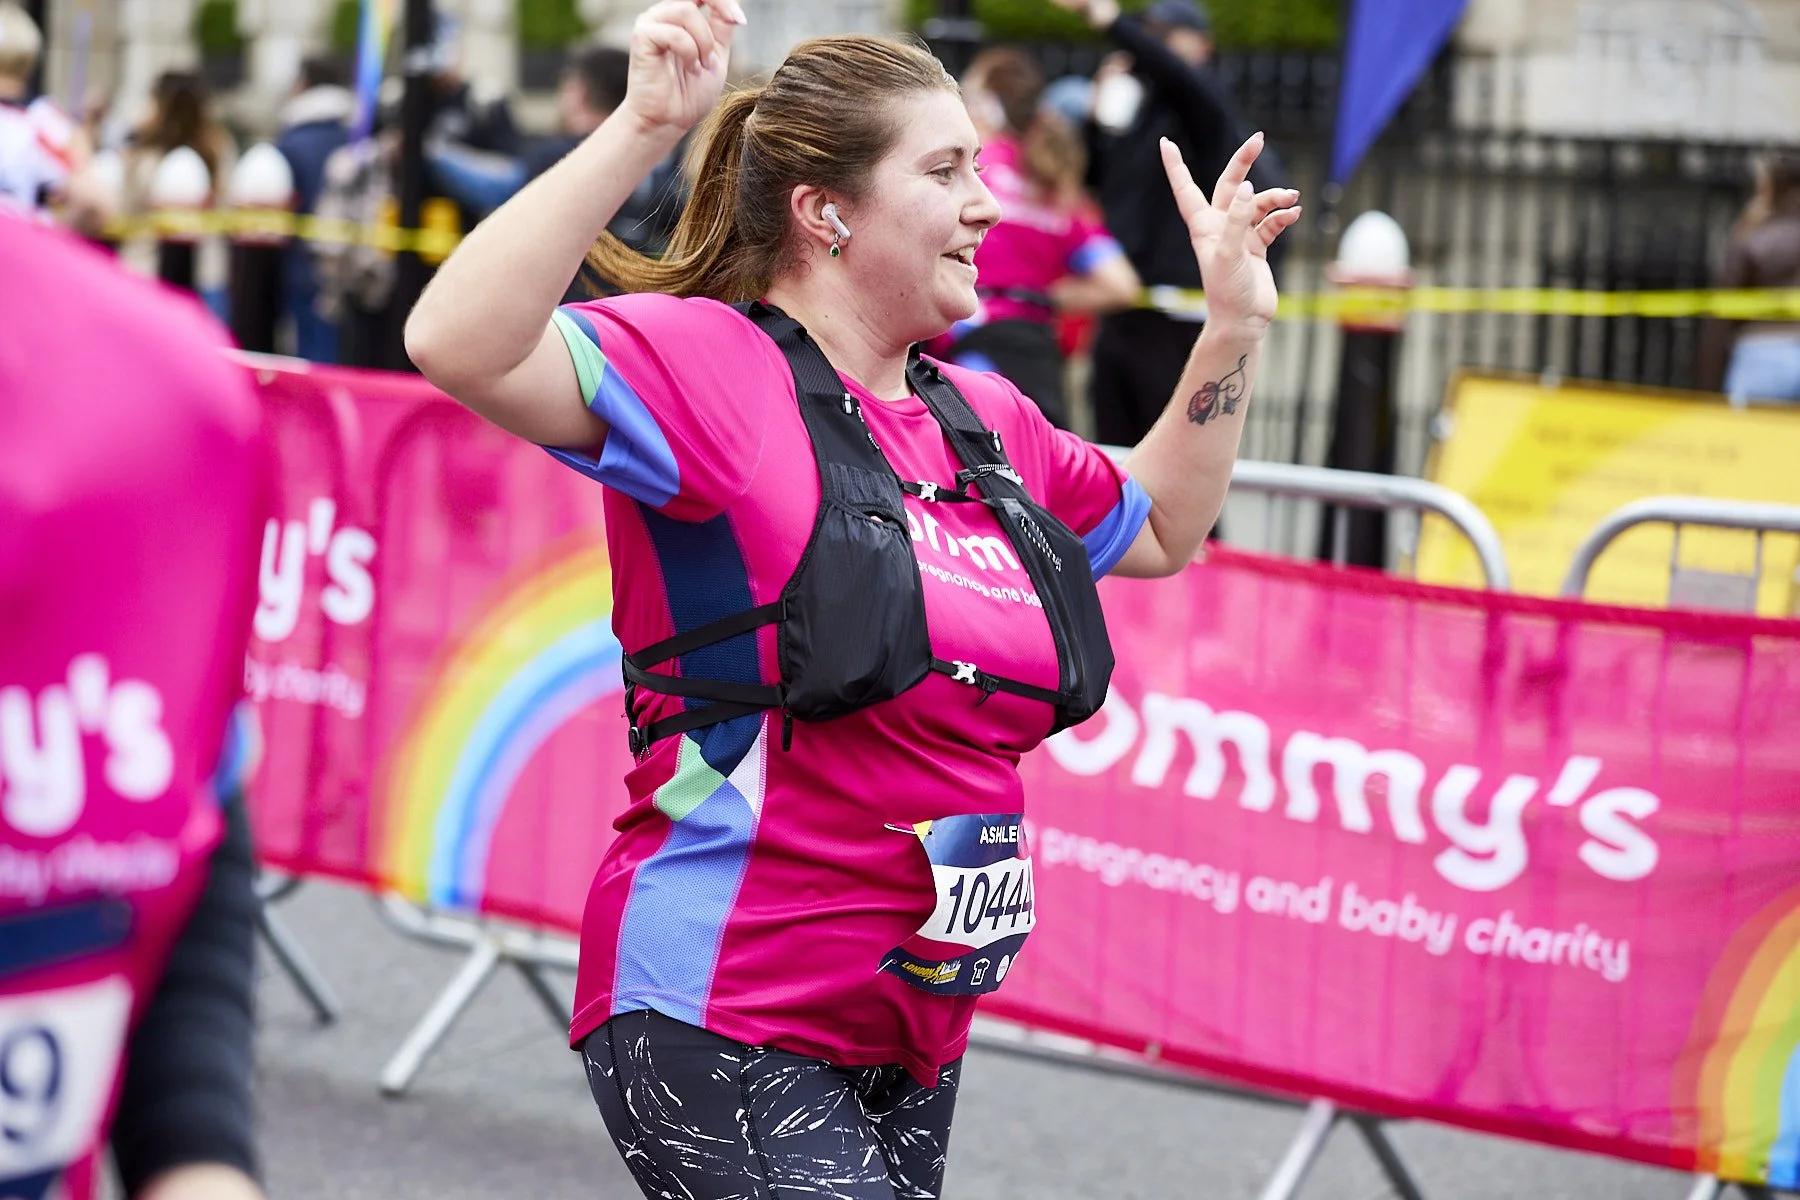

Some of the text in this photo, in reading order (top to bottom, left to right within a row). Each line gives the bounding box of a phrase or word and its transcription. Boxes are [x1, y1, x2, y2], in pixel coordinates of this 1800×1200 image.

[945, 864, 1033, 934] 10444
[1041, 827, 1241, 915] pregnancy
[1245, 874, 1333, 924] and
[1339, 880, 1458, 956] baby
[1465, 910, 1631, 983] charity
